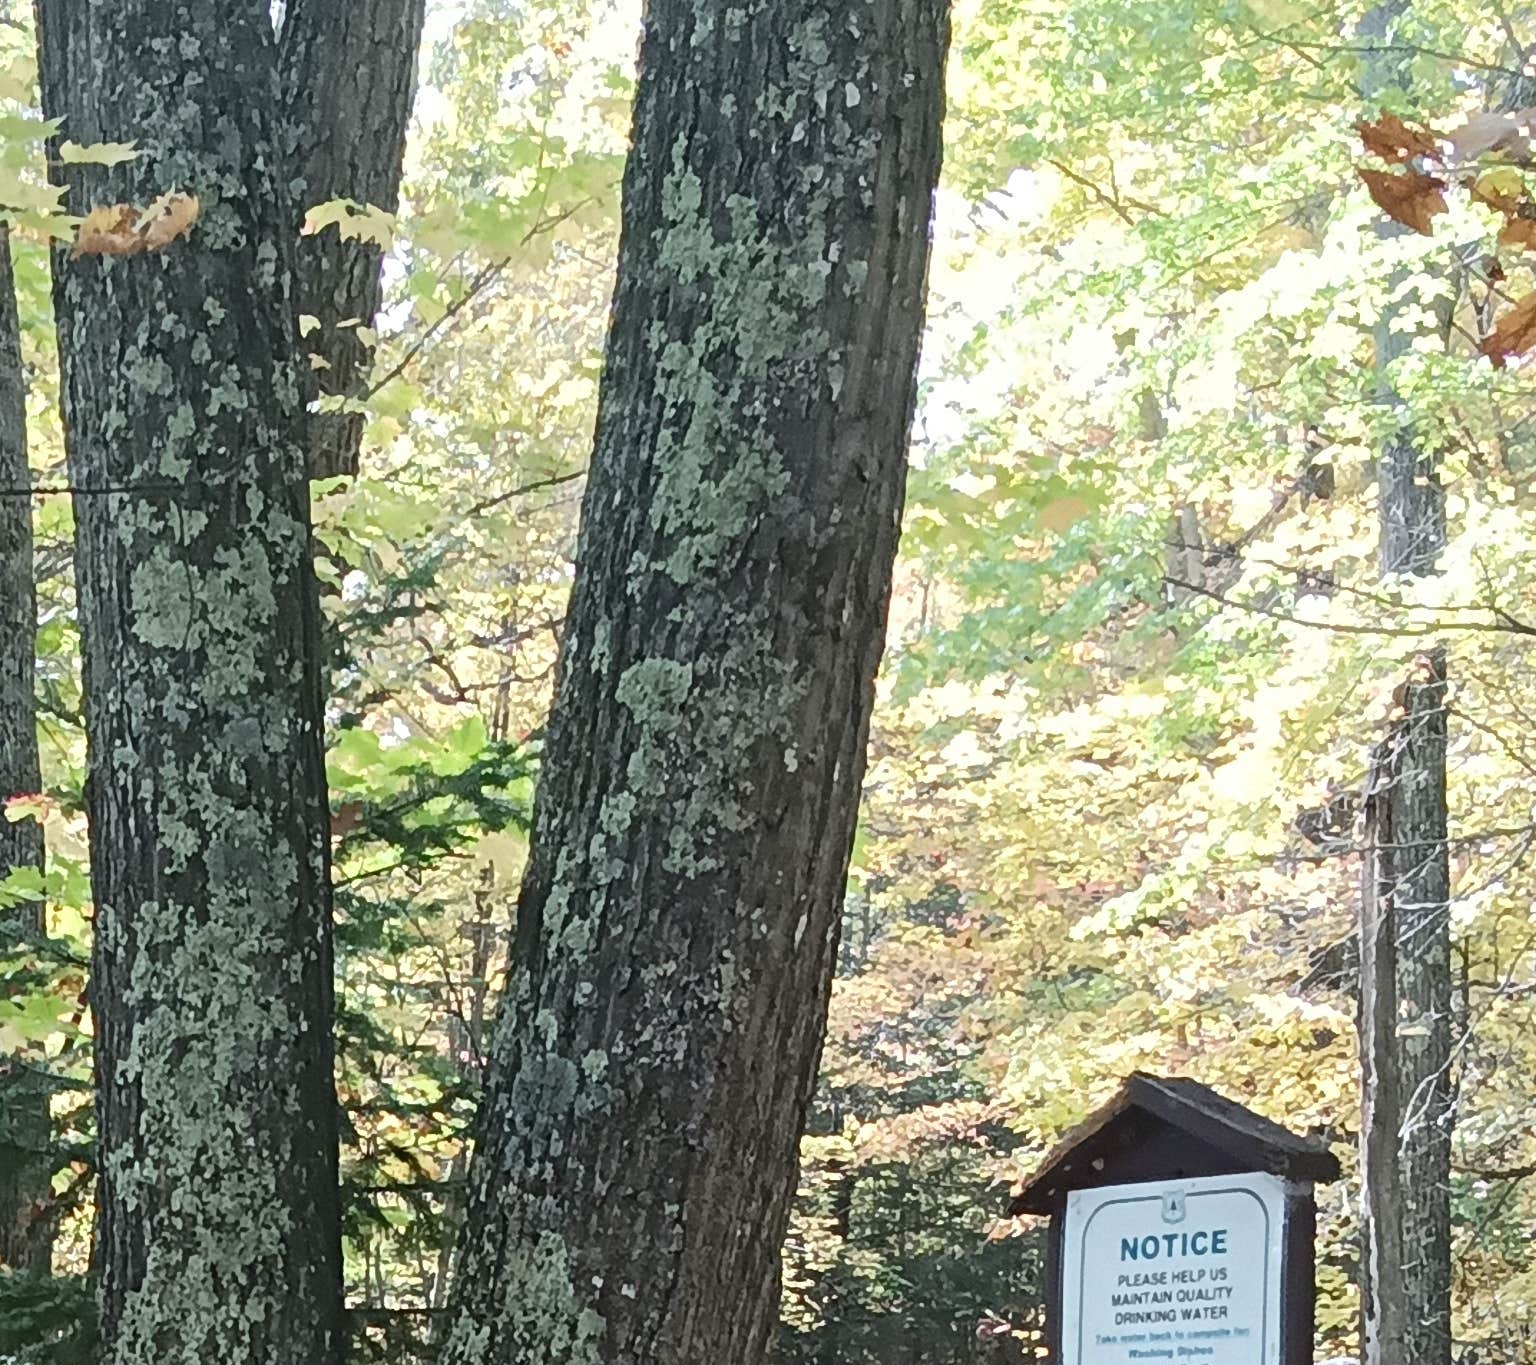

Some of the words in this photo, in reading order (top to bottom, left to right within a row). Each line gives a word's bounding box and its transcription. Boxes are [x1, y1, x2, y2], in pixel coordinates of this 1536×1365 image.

[1121, 1229, 1228, 1261] NOTICE
[1118, 1271, 1167, 1287] PLEASE
[1171, 1268, 1205, 1283] HELP
[1210, 1267, 1228, 1281] US
[1112, 1291, 1172, 1306] MAINTAIN
[1176, 1286, 1232, 1302] QUALITY
[1114, 1309, 1176, 1325] DRINKING
[1181, 1306, 1228, 1320] WATER
[1129, 1348, 1173, 1358] Washing
